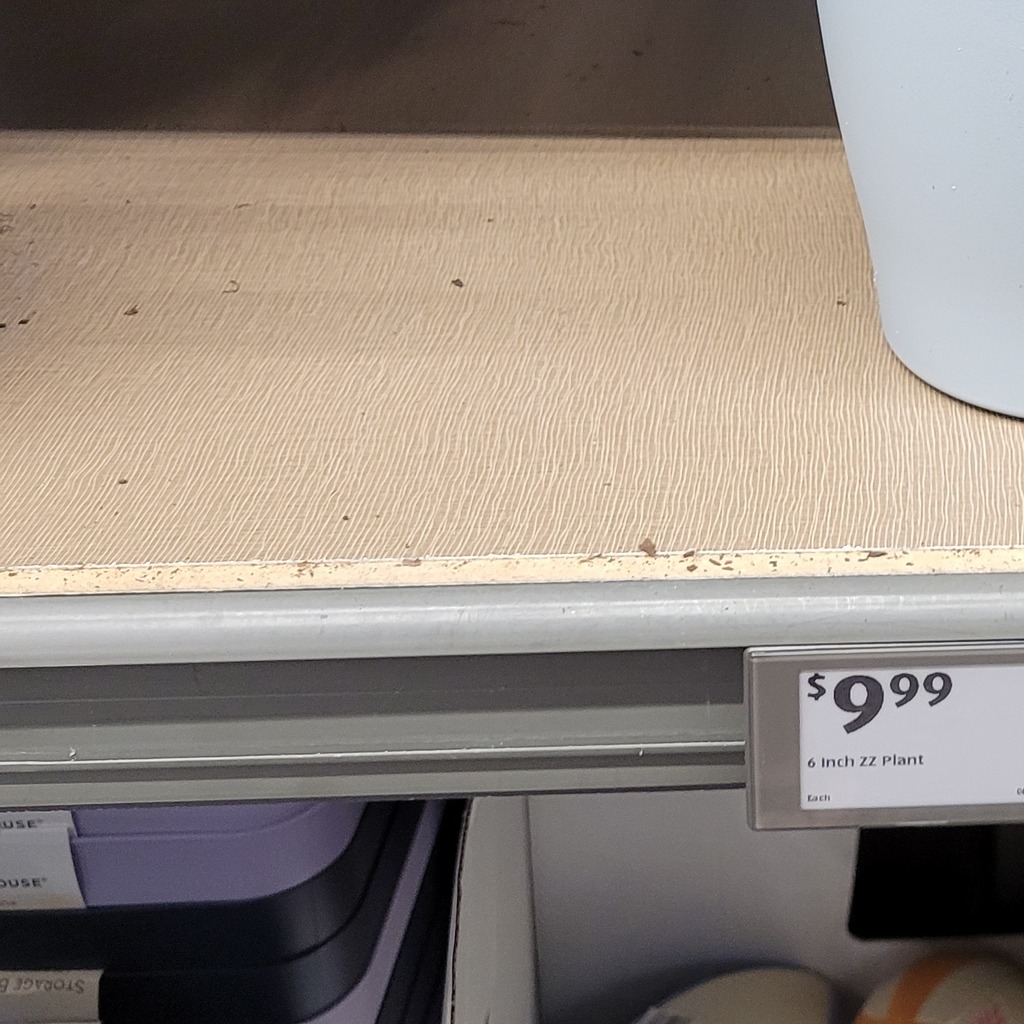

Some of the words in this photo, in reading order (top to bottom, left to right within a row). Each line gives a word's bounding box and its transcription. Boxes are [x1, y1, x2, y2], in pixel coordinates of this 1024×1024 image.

[807, 757, 816, 769] 6
[821, 755, 855, 768] Inch
[860, 755, 877, 767] ZZ
[882, 754, 924, 766] Plant
[807, 794, 831, 803] Each
[0, 819, 39, 829] USE
[13, 977, 86, 995] STORAGE
